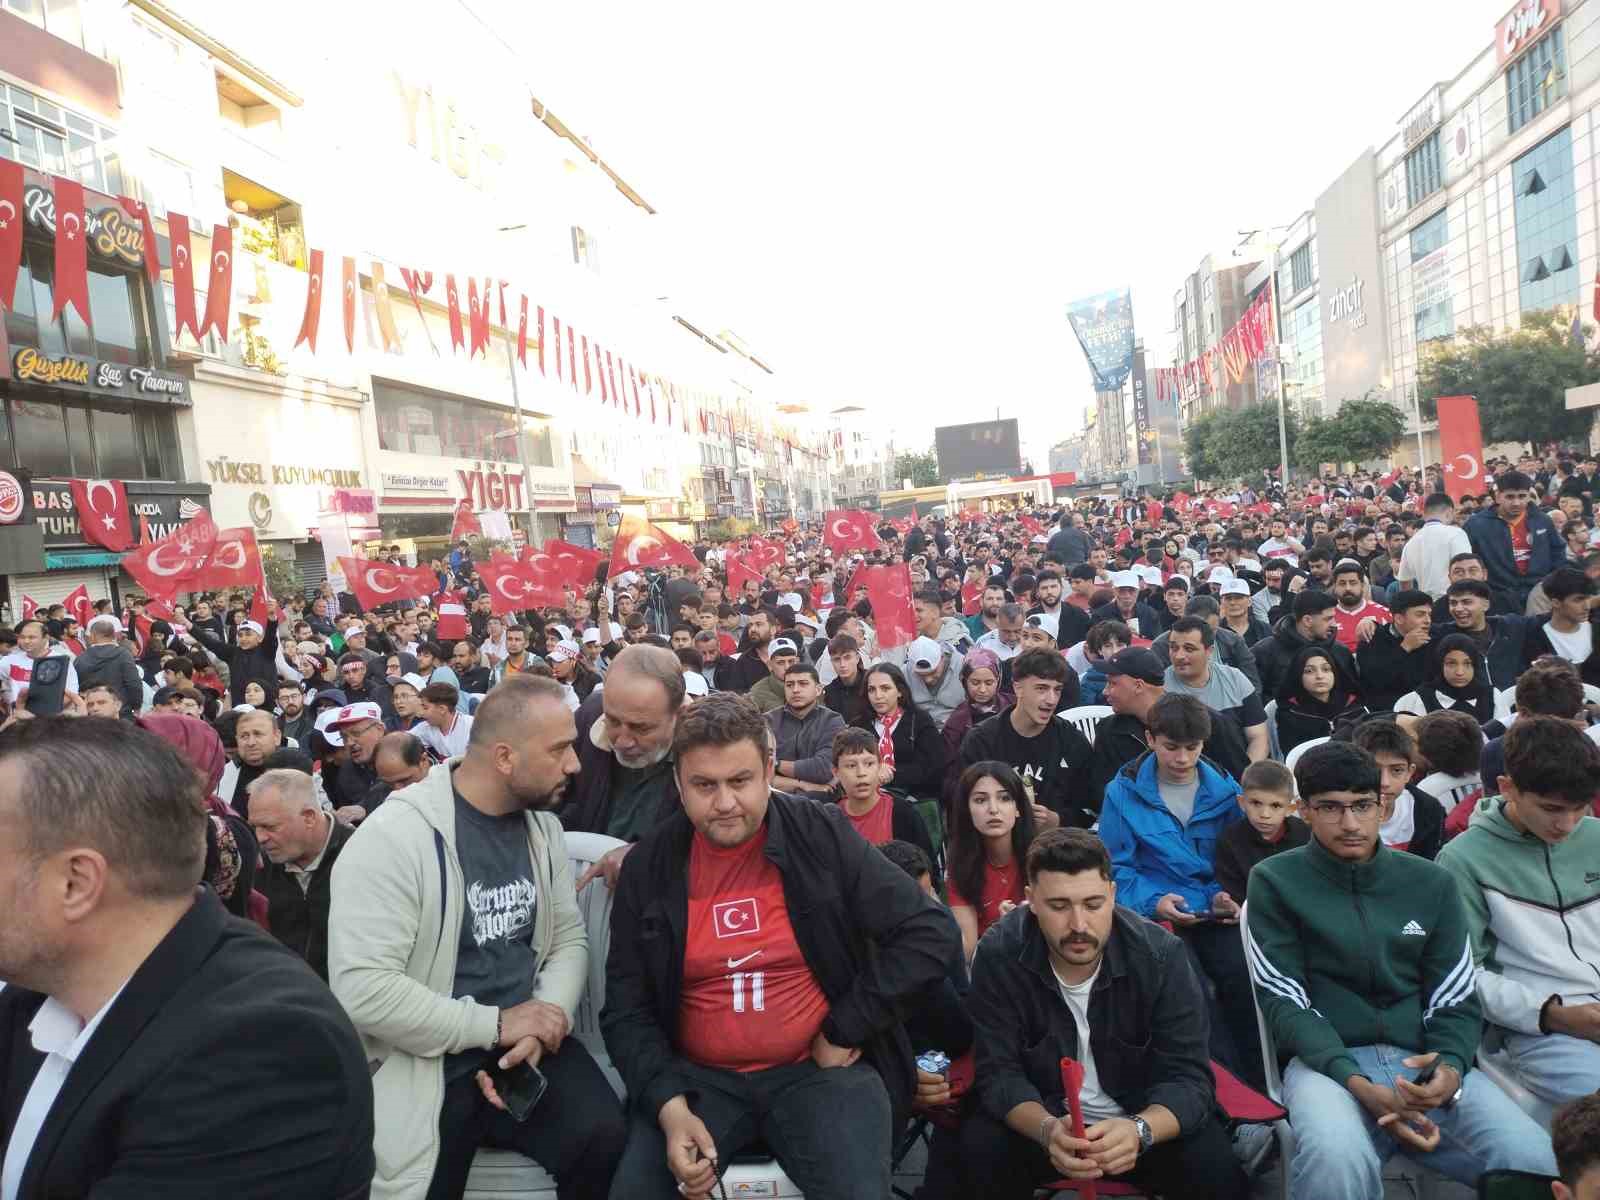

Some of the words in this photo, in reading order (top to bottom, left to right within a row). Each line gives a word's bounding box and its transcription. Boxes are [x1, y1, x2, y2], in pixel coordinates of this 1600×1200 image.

[206, 456, 266, 484] YÜKSEL
[271, 465, 361, 488] KUYUMCULUK
[456, 462, 525, 511] YİĞİT
[729, 971, 765, 1013] 11
